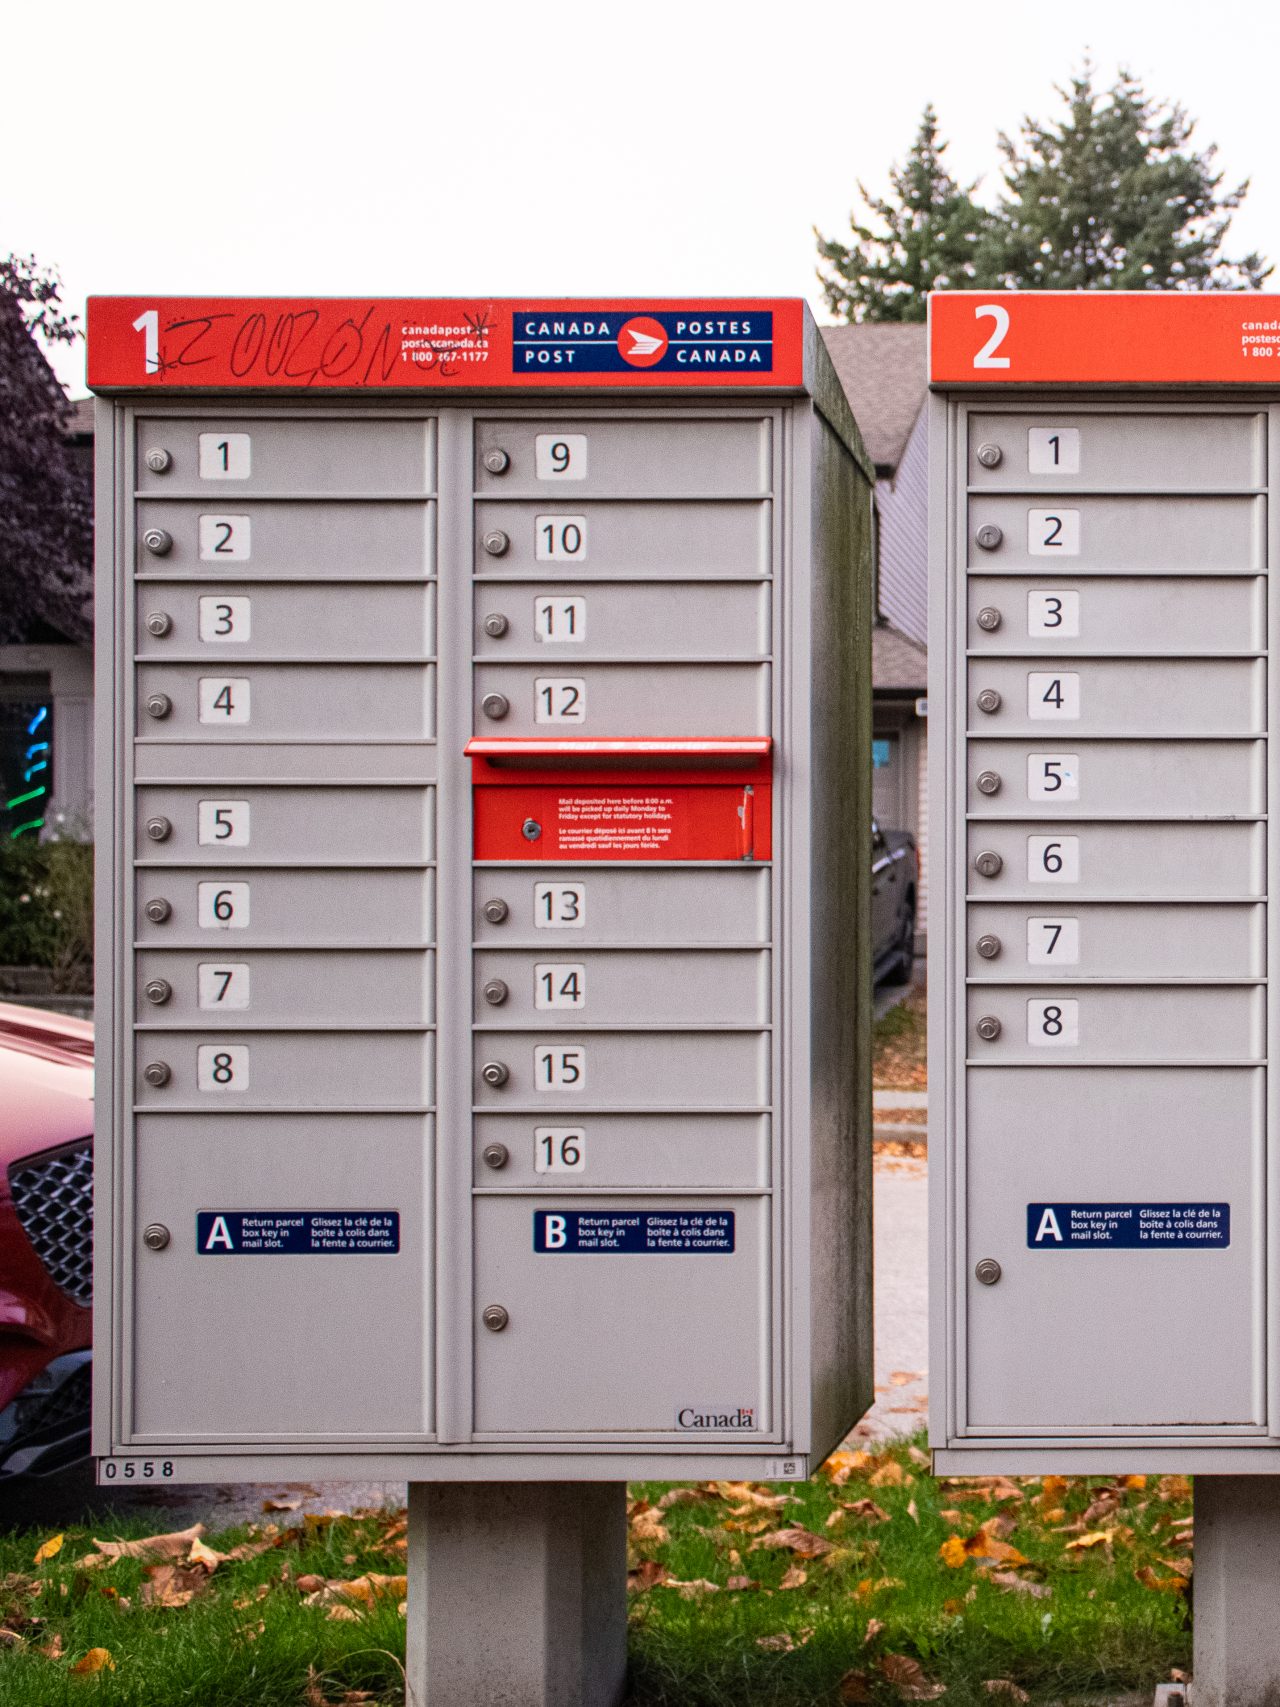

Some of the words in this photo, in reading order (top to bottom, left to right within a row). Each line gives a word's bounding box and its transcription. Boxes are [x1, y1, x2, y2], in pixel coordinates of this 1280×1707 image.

[132, 310, 159, 374] 1
[401, 324, 489, 336] canadaposta
[525, 322, 610, 335] CANADA
[677, 321, 751, 335] POSTES
[973, 304, 1010, 369] 2
[402, 351, 407, 362] 1
[525, 350, 575, 363] POST
[676, 349, 761, 363] CANADA
[1242, 347, 1248, 356] 1
[1252, 347, 1273, 357] 800
[217, 441, 229, 471] 1
[551, 442, 570, 473] 9
[1048, 436, 1059, 465] 1
[214, 522, 233, 553] 2
[543, 524, 581, 554] 10
[1044, 516, 1062, 546] 2
[215, 604, 233, 635] 3
[542, 605, 575, 634] 11
[1044, 597, 1062, 628] 3
[213, 686, 235, 716] 4
[542, 686, 579, 716] 12
[1043, 679, 1064, 709] 4
[1044, 762, 1062, 792] 5
[215, 809, 233, 839] 5
[1043, 843, 1063, 873] 6
[214, 890, 233, 921] 6
[542, 890, 579, 921] 13
[1043, 925, 1062, 954] 7
[213, 971, 233, 1002] 7
[542, 972, 581, 1002] 14
[1042, 1006, 1063, 1036] 8
[212, 1053, 233, 1084] 8
[542, 1053, 580, 1084] 15
[541, 1135, 580, 1166] 16
[205, 1216, 234, 1249] A
[545, 1215, 567, 1248] B
[1035, 1208, 1063, 1241] A
[678, 1408, 753, 1428] Canada
